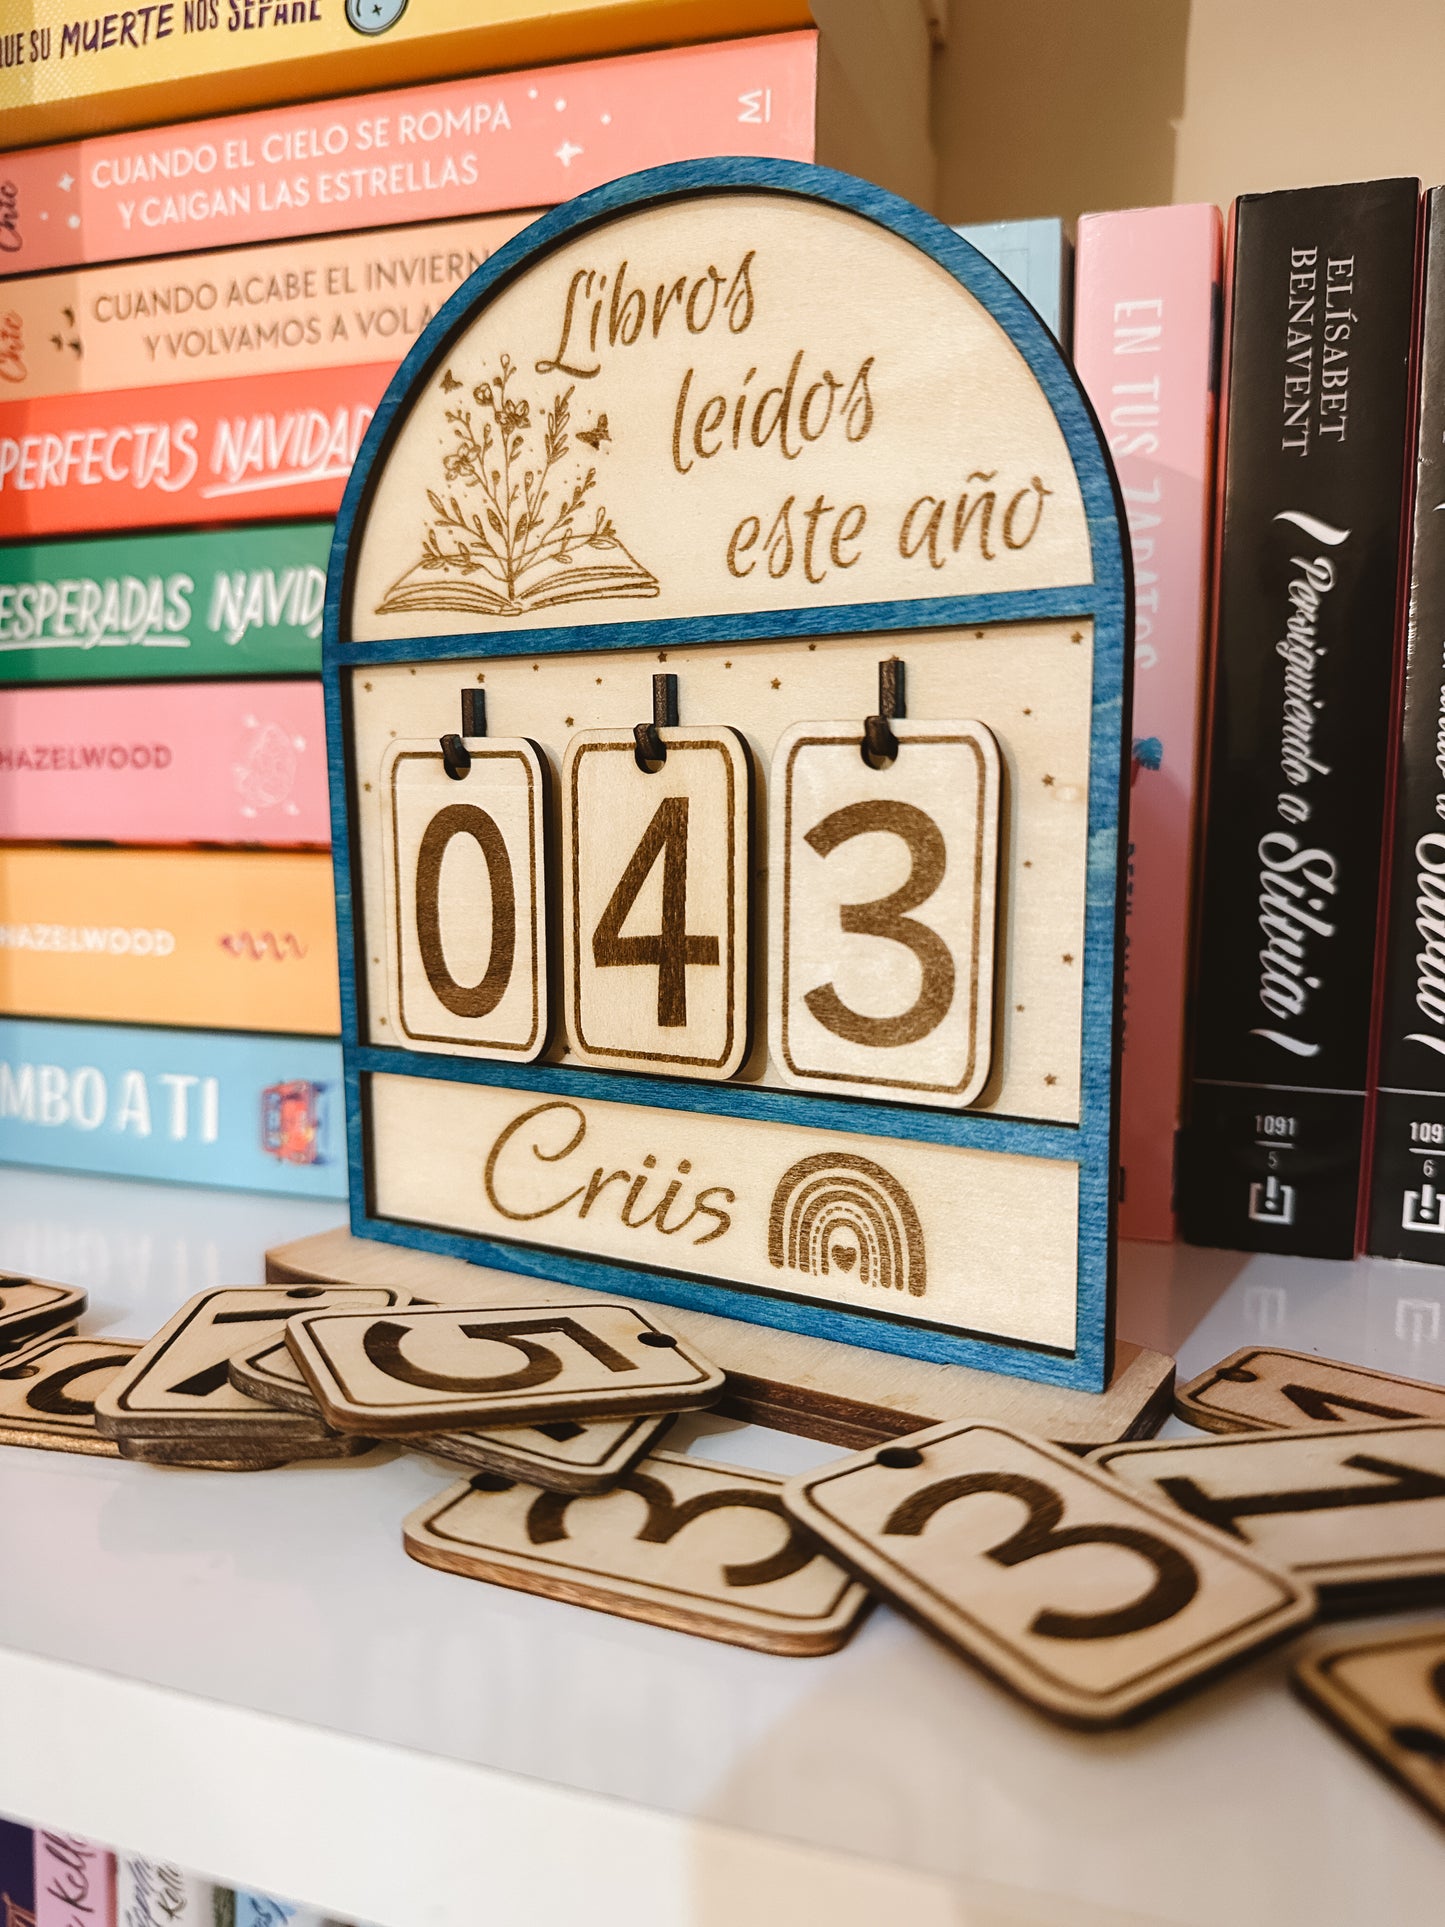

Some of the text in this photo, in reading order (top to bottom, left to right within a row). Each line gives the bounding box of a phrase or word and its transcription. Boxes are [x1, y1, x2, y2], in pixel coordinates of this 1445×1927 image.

[0, 32, 24, 69] UE
[30, 27, 51, 62] SU
[60, 3, 174, 59] MUERTE
[184, 0, 219, 34] NOS
[91, 98, 512, 189] CUANDO EL CIELO SE ROMPA
[117, 151, 478, 230] Y CAIGAN LAS ESTRELLAS
[93, 282, 218, 323] CUANDO
[226, 268, 318, 308] ACABE
[327, 265, 357, 297] EL
[535, 250, 757, 378] Libros
[144, 334, 160, 362] Y
[164, 315, 322, 360] VOLVAMOS
[330, 312, 349, 343] A
[1110, 298, 1163, 459] EN TUS
[1281, 246, 1319, 457] BENAVENT
[1319, 254, 1359, 442] ELÍSABET
[671, 350, 876, 475] leídos
[0, 419, 199, 492] PERFECTAS
[726, 470, 1054, 584] este año
[0, 571, 195, 648] ESPERADAS
[1257, 556, 1338, 1020] Persiguiendo a Silvia
[1255, 1114, 1297, 1138] 1091
[1268, 1151, 1280, 1170] 5
[1409, 1121, 1445, 1145] 109
[1422, 1159, 1435, 1178] 6
[362, 1316, 640, 1394] 5
[526, 1470, 828, 1588] 3
[1154, 1454, 1445, 1545] 1
[881, 1471, 1201, 1640] 3
